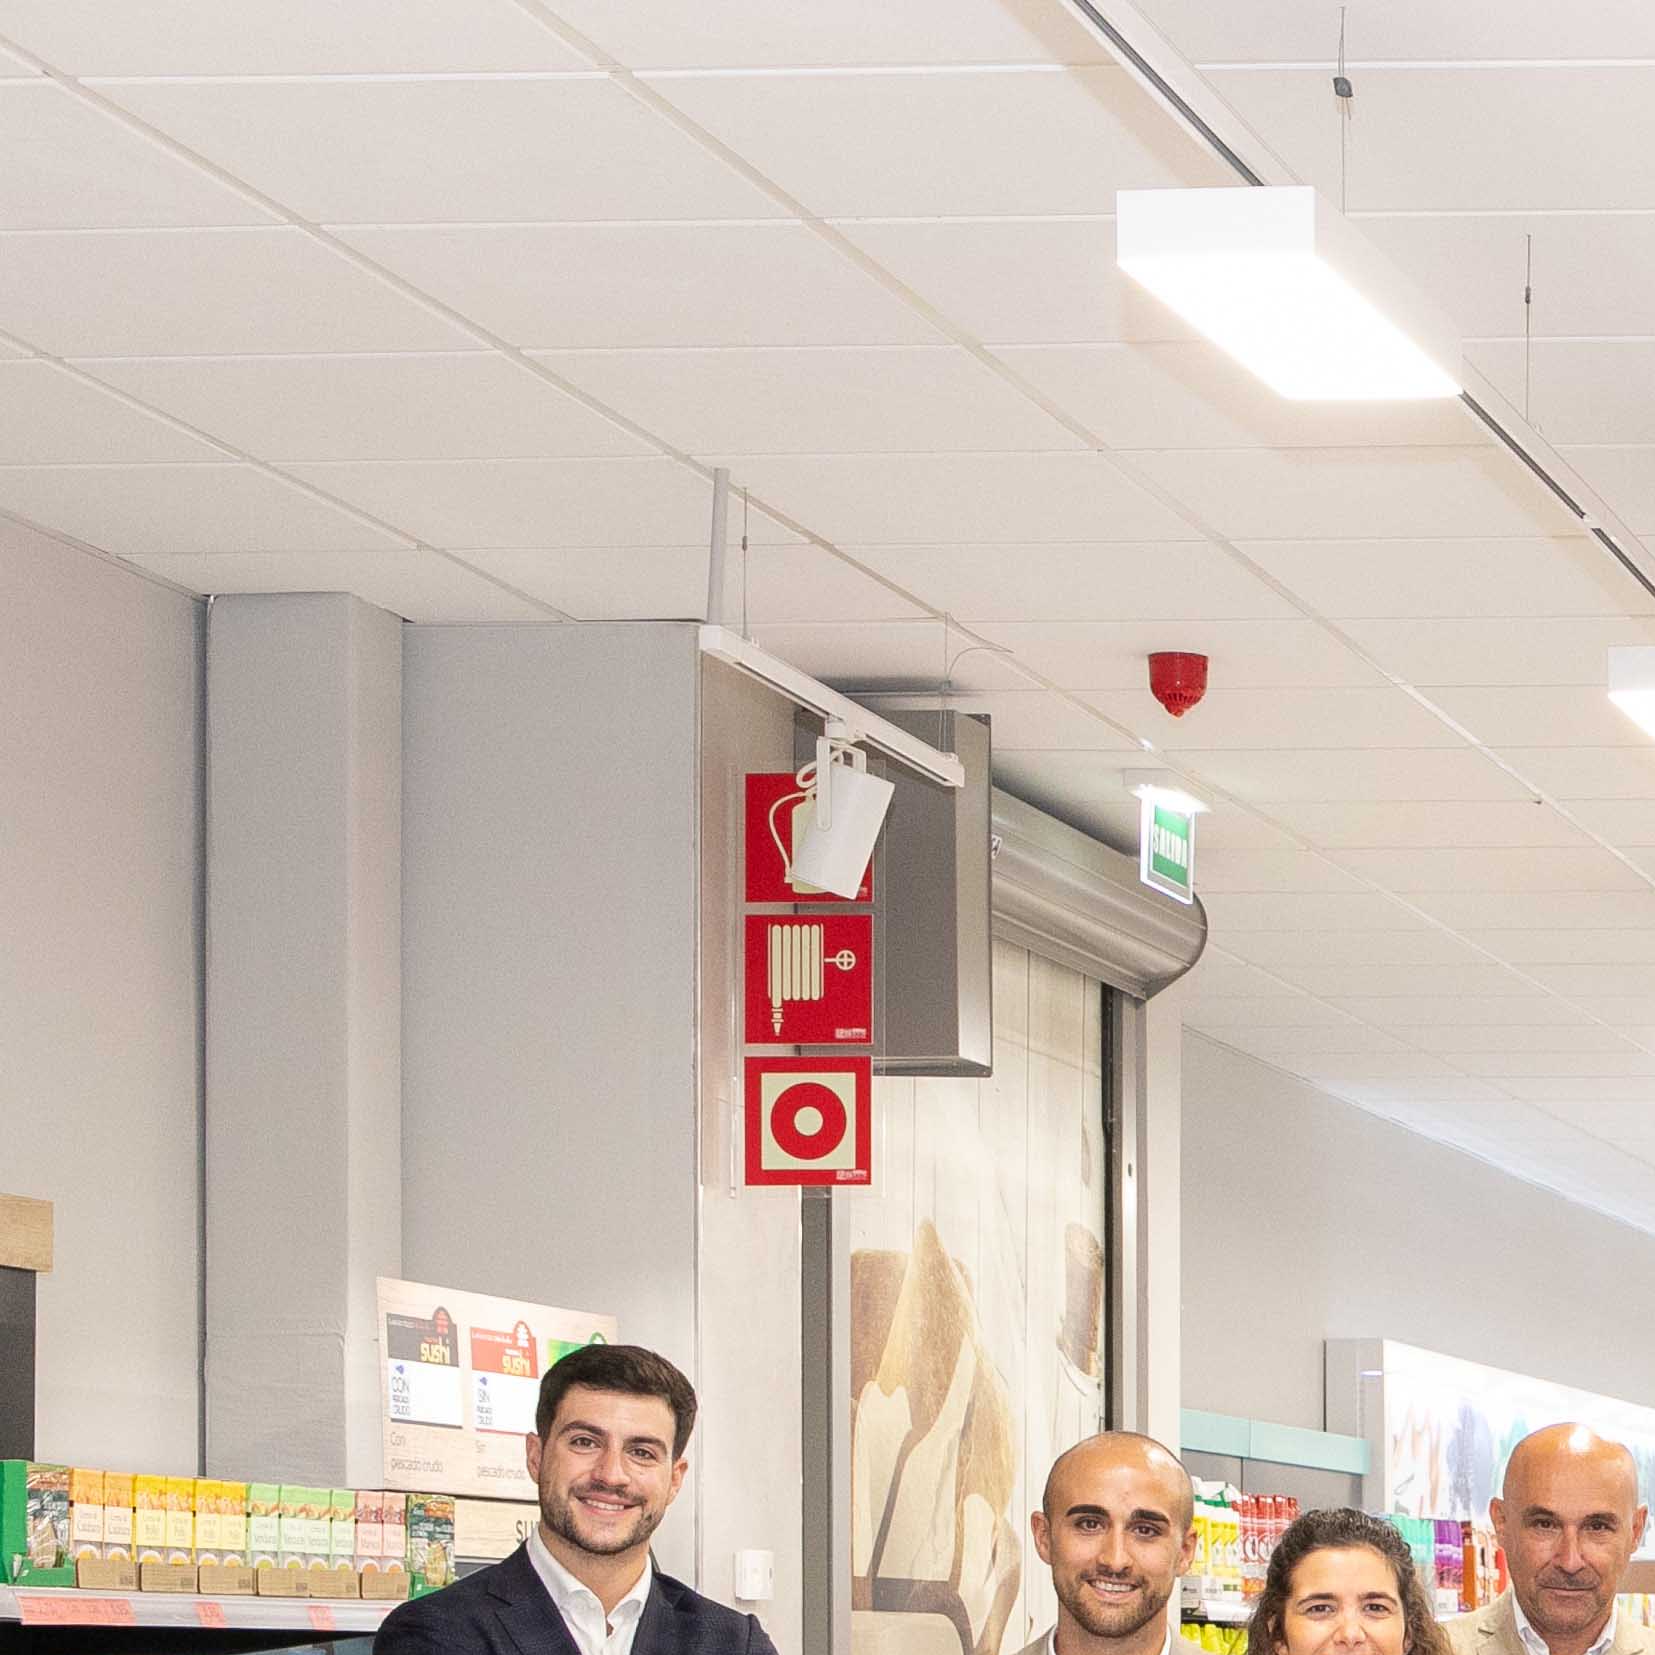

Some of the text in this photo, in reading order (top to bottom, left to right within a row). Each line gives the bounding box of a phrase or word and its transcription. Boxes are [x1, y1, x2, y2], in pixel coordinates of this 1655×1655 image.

[1154, 822, 1188, 869] SALIDA
[420, 1337, 450, 1363] sushi
[502, 1350, 530, 1376] sushi
